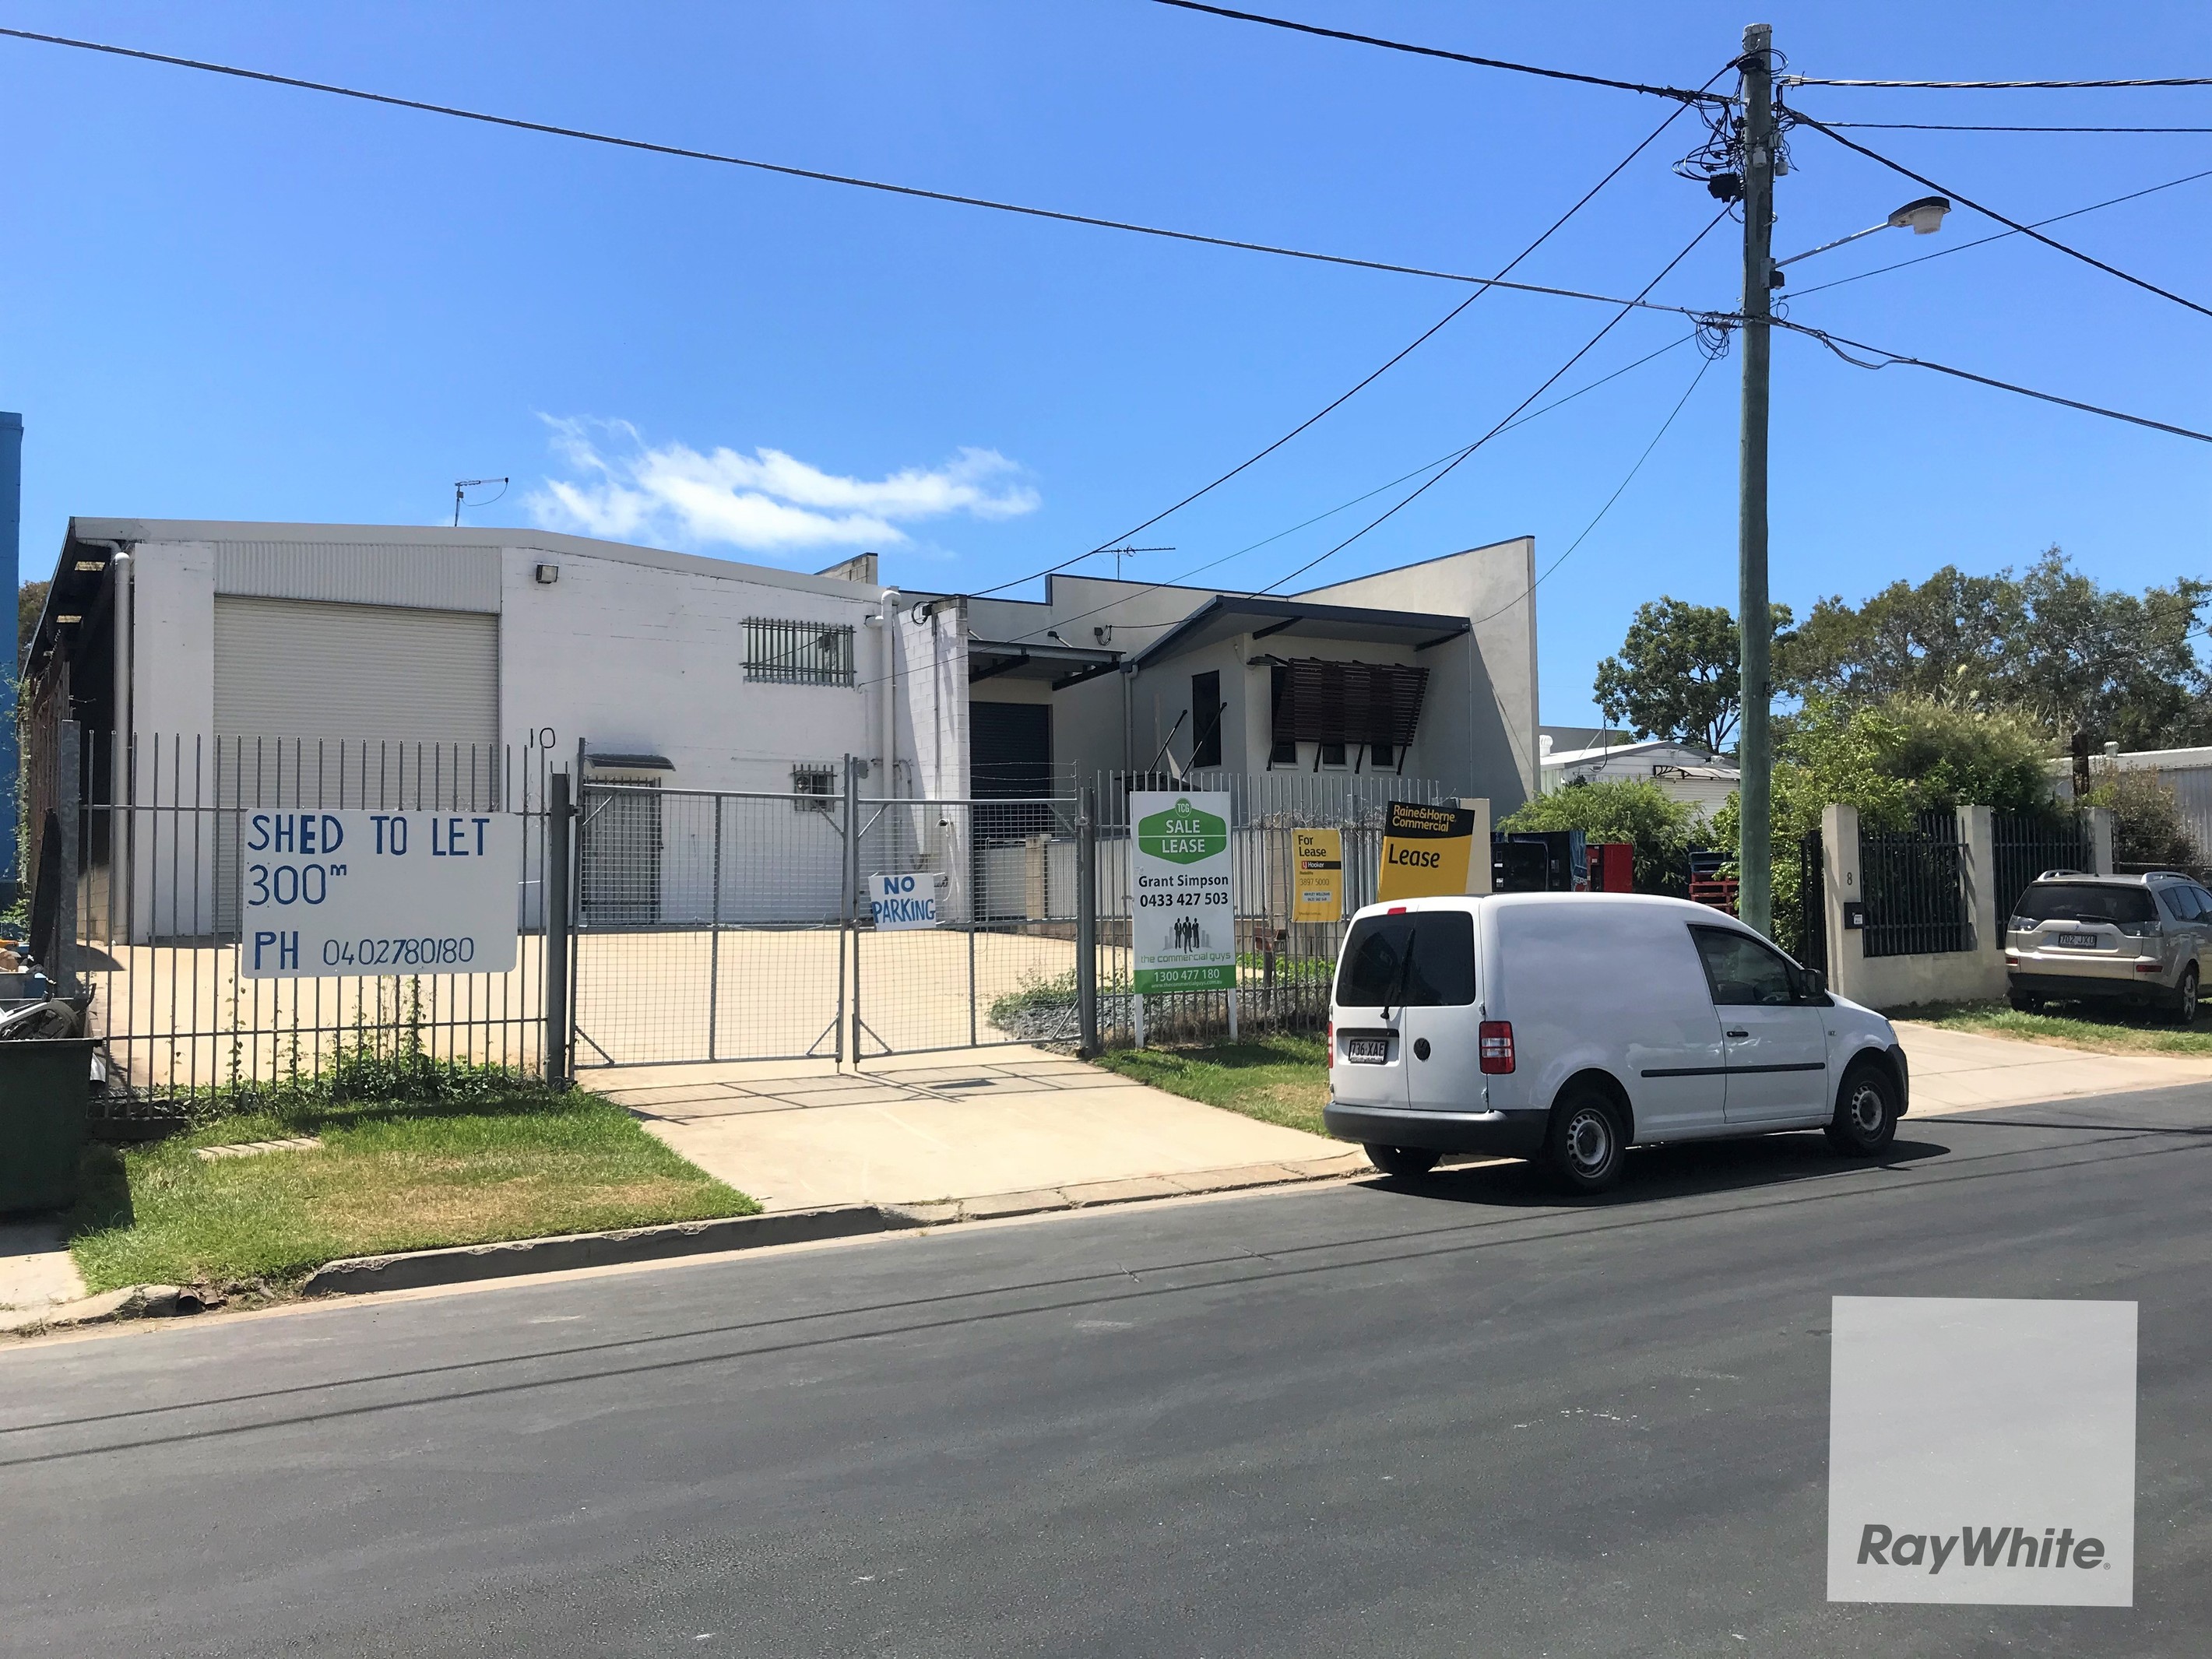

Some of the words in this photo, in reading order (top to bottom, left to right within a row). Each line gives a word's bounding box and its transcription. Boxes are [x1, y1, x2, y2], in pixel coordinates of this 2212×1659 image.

[530, 727, 556, 749] 10
[1177, 803, 1190, 814] TCG
[1394, 804, 1455, 822] Raine&Horne
[1166, 820, 1201, 834] SALE
[1392, 816, 1449, 832] Commercial
[248, 815, 344, 855] SHED
[371, 816, 408, 856] TO
[432, 818, 490, 856] LET
[1298, 835, 1313, 845] For
[1162, 839, 1205, 853] LEASE
[1299, 846, 1327, 857] Lease
[1388, 843, 1440, 868] Lease
[1138, 877, 1174, 887] Grant
[1177, 874, 1229, 889] Simpson
[1573, 876, 1588, 885] PEPS
[1847, 872, 1852, 885] 8
[884, 877, 915, 895] NO
[1140, 894, 1173, 907] 0433
[1176, 893, 1201, 905] 427
[1204, 892, 1229, 905] 503
[254, 931, 299, 970] PH
[1157, 952, 1208, 962] commercial
[1210, 952, 1231, 961] guys
[1154, 971, 1179, 982] 1300
[1180, 969, 1199, 980] 477
[1201, 968, 1220, 979] 180
